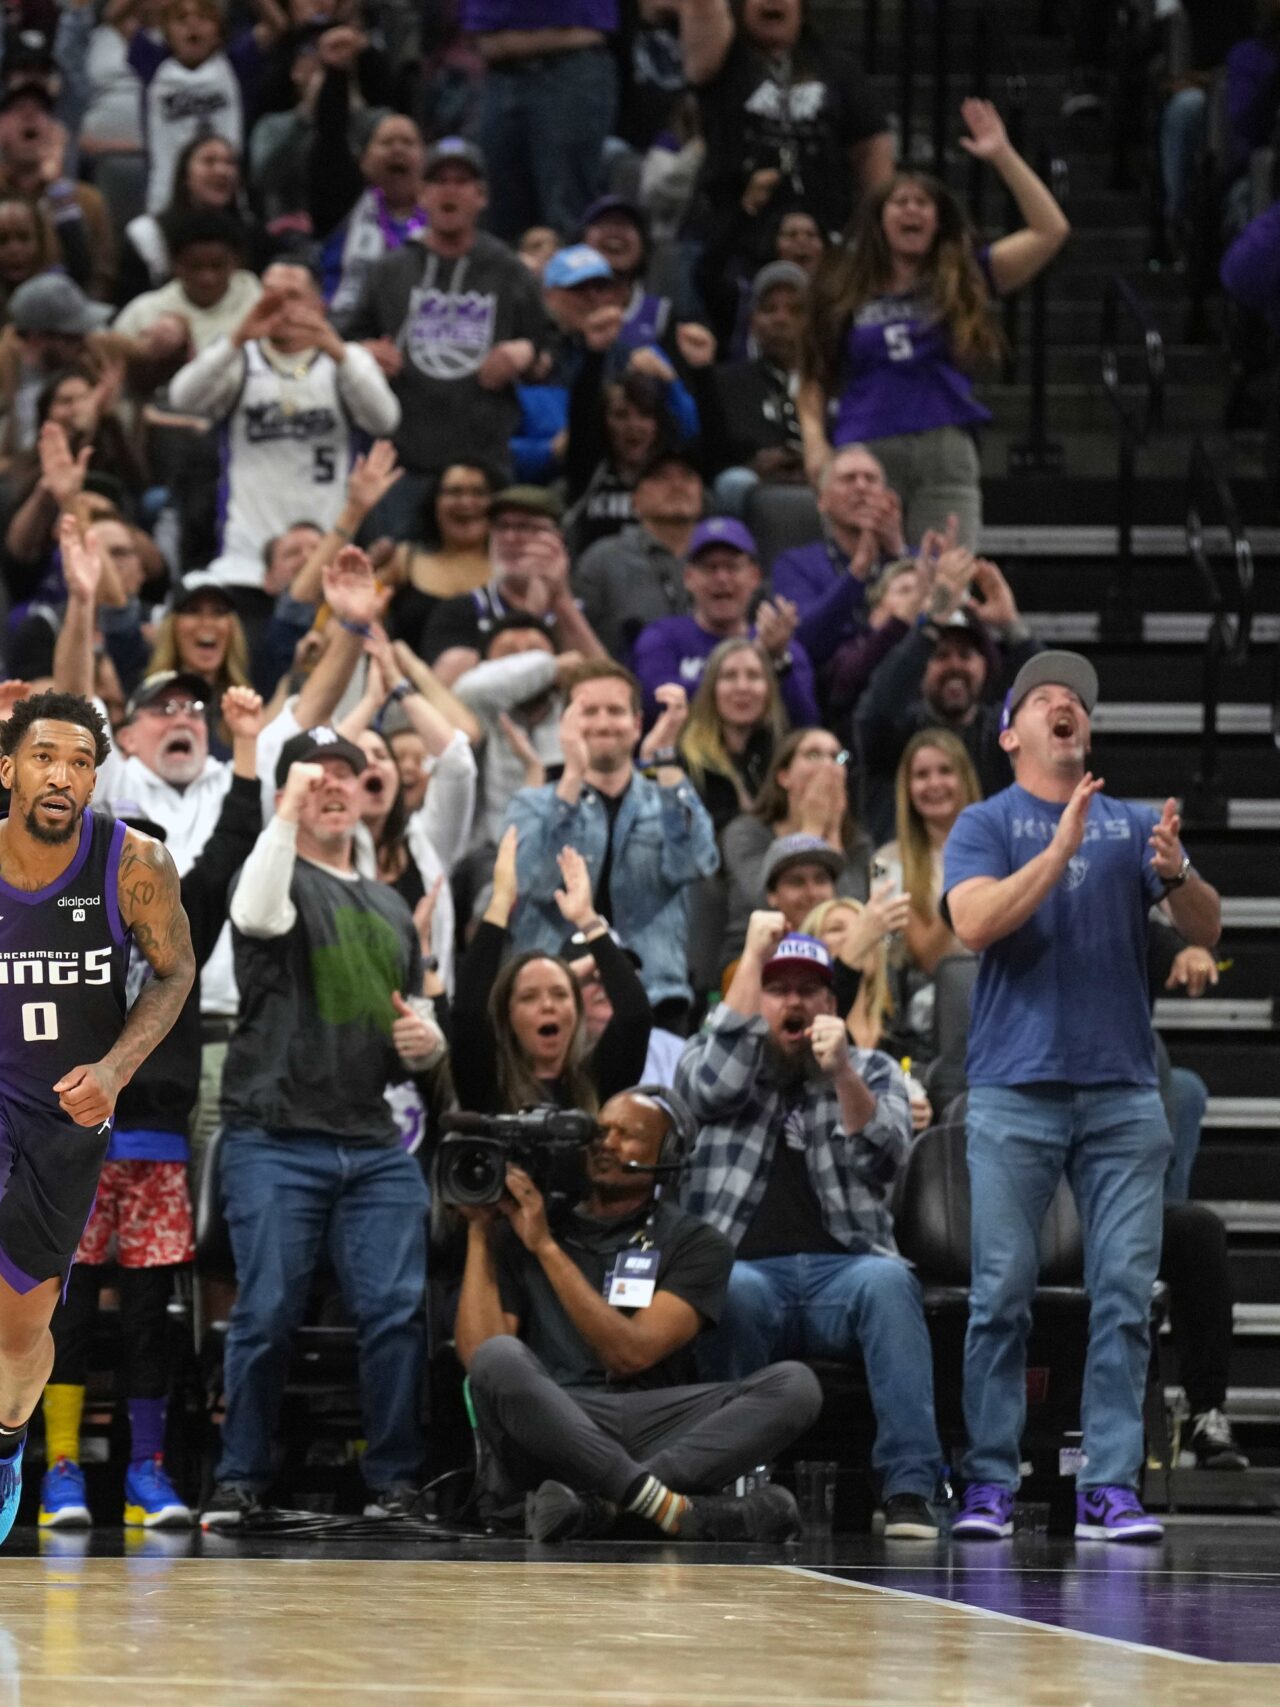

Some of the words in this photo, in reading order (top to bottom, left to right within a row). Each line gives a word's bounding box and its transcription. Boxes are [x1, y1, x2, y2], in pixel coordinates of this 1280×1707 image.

[884, 323, 914, 361] 5
[313, 446, 336, 483] 5
[57, 895, 101, 908] dialpad
[21, 1002, 59, 1042] 0
